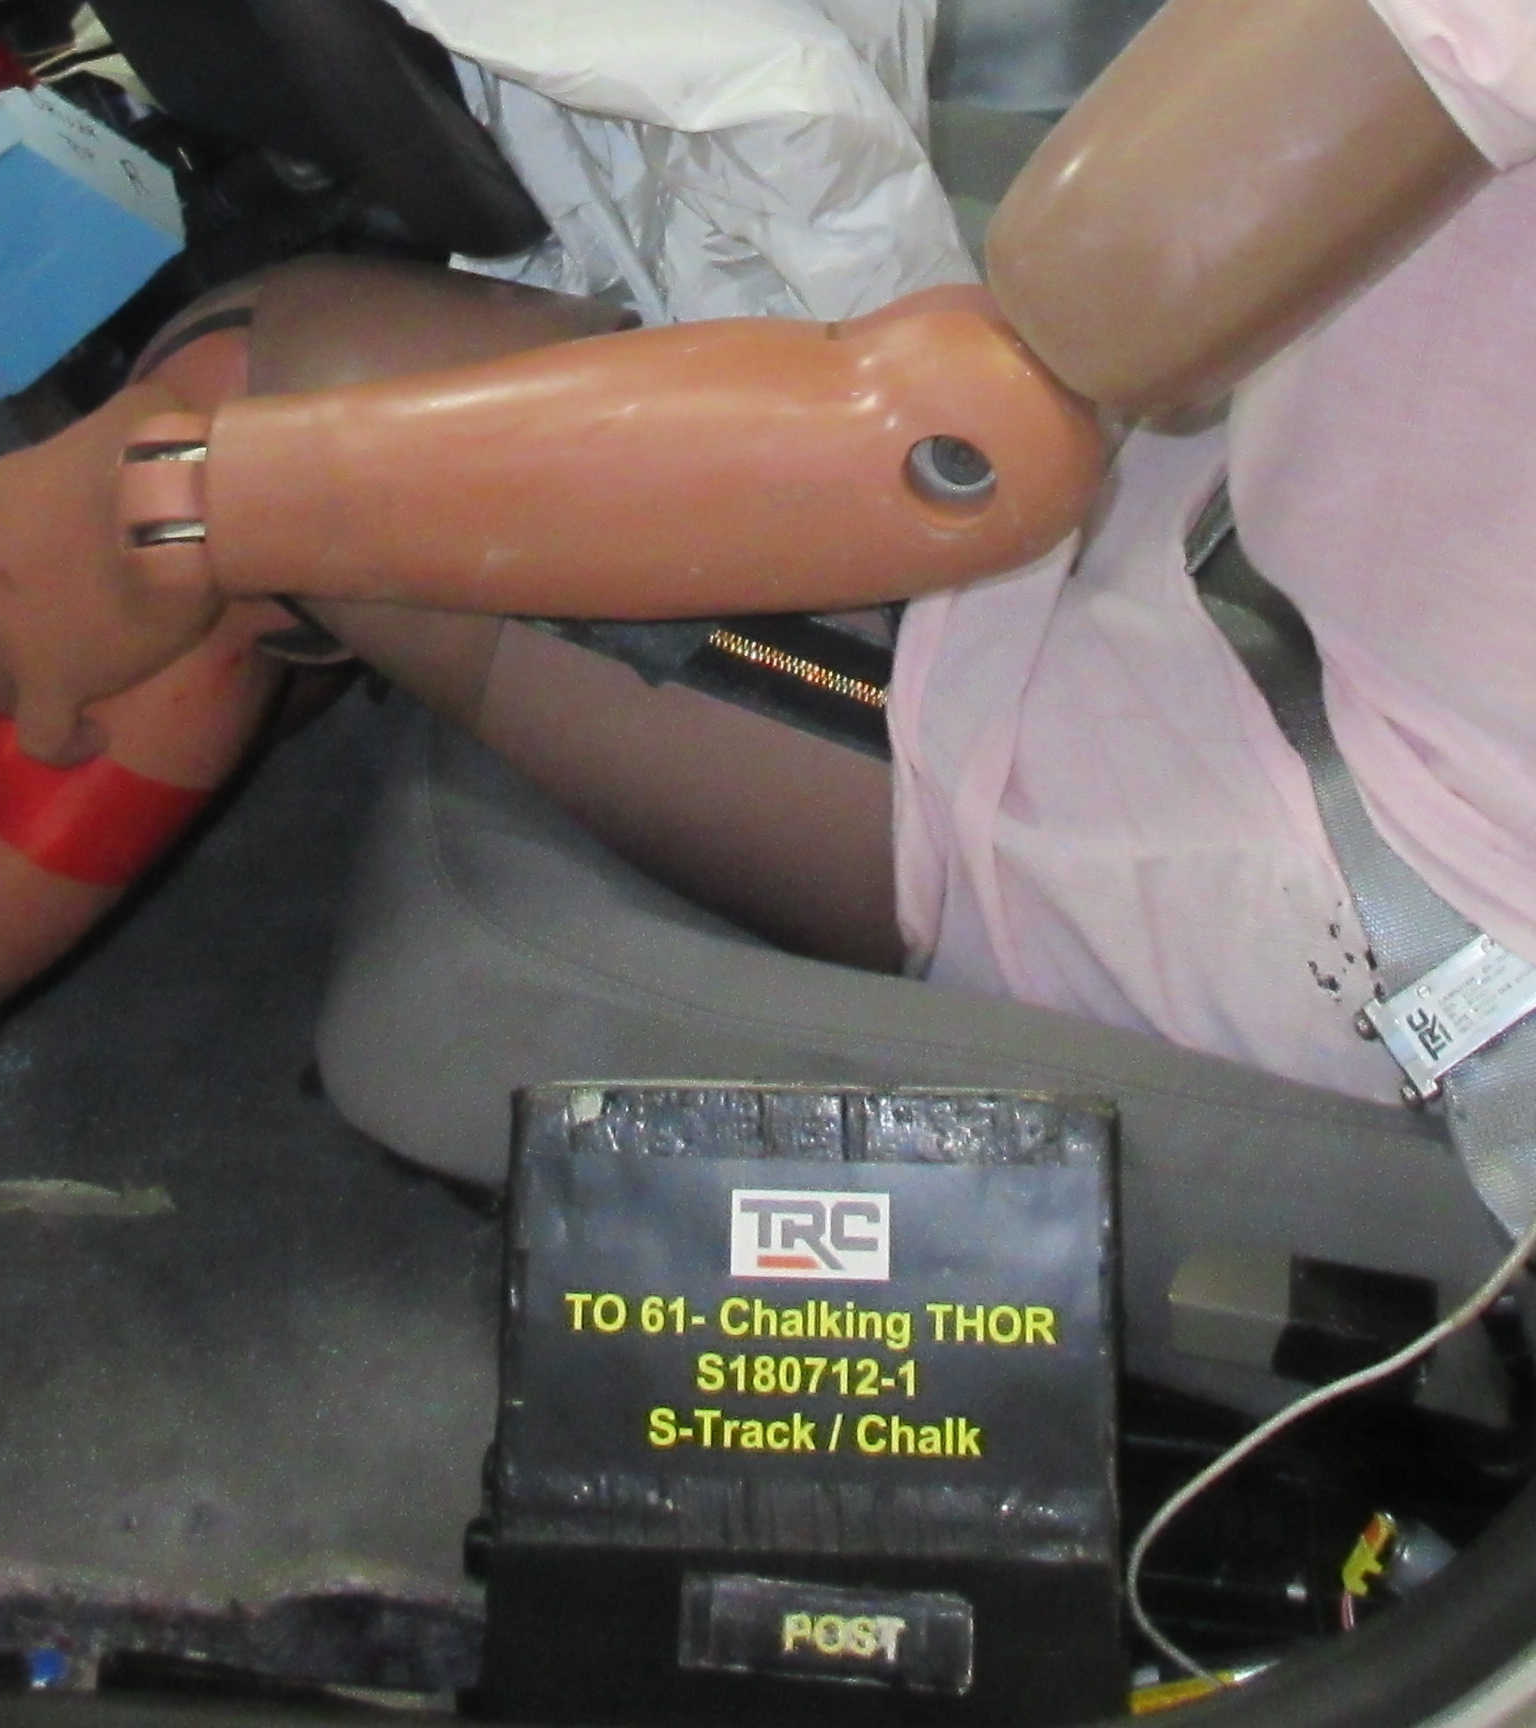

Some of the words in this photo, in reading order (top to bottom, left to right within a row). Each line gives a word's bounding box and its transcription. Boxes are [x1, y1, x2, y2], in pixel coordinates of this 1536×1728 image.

[1405, 1007, 1453, 1061] TRC
[739, 1198, 880, 1270] TRC
[565, 1293, 627, 1332] TO
[640, 1296, 706, 1334] 61-
[719, 1298, 913, 1349] Chalking
[926, 1304, 1057, 1344] THOR
[696, 1353, 917, 1397] S180712-1
[648, 1408, 816, 1452] S-Track
[827, 1414, 842, 1452] /
[855, 1415, 982, 1456] Chalk
[782, 1613, 908, 1662] POST
